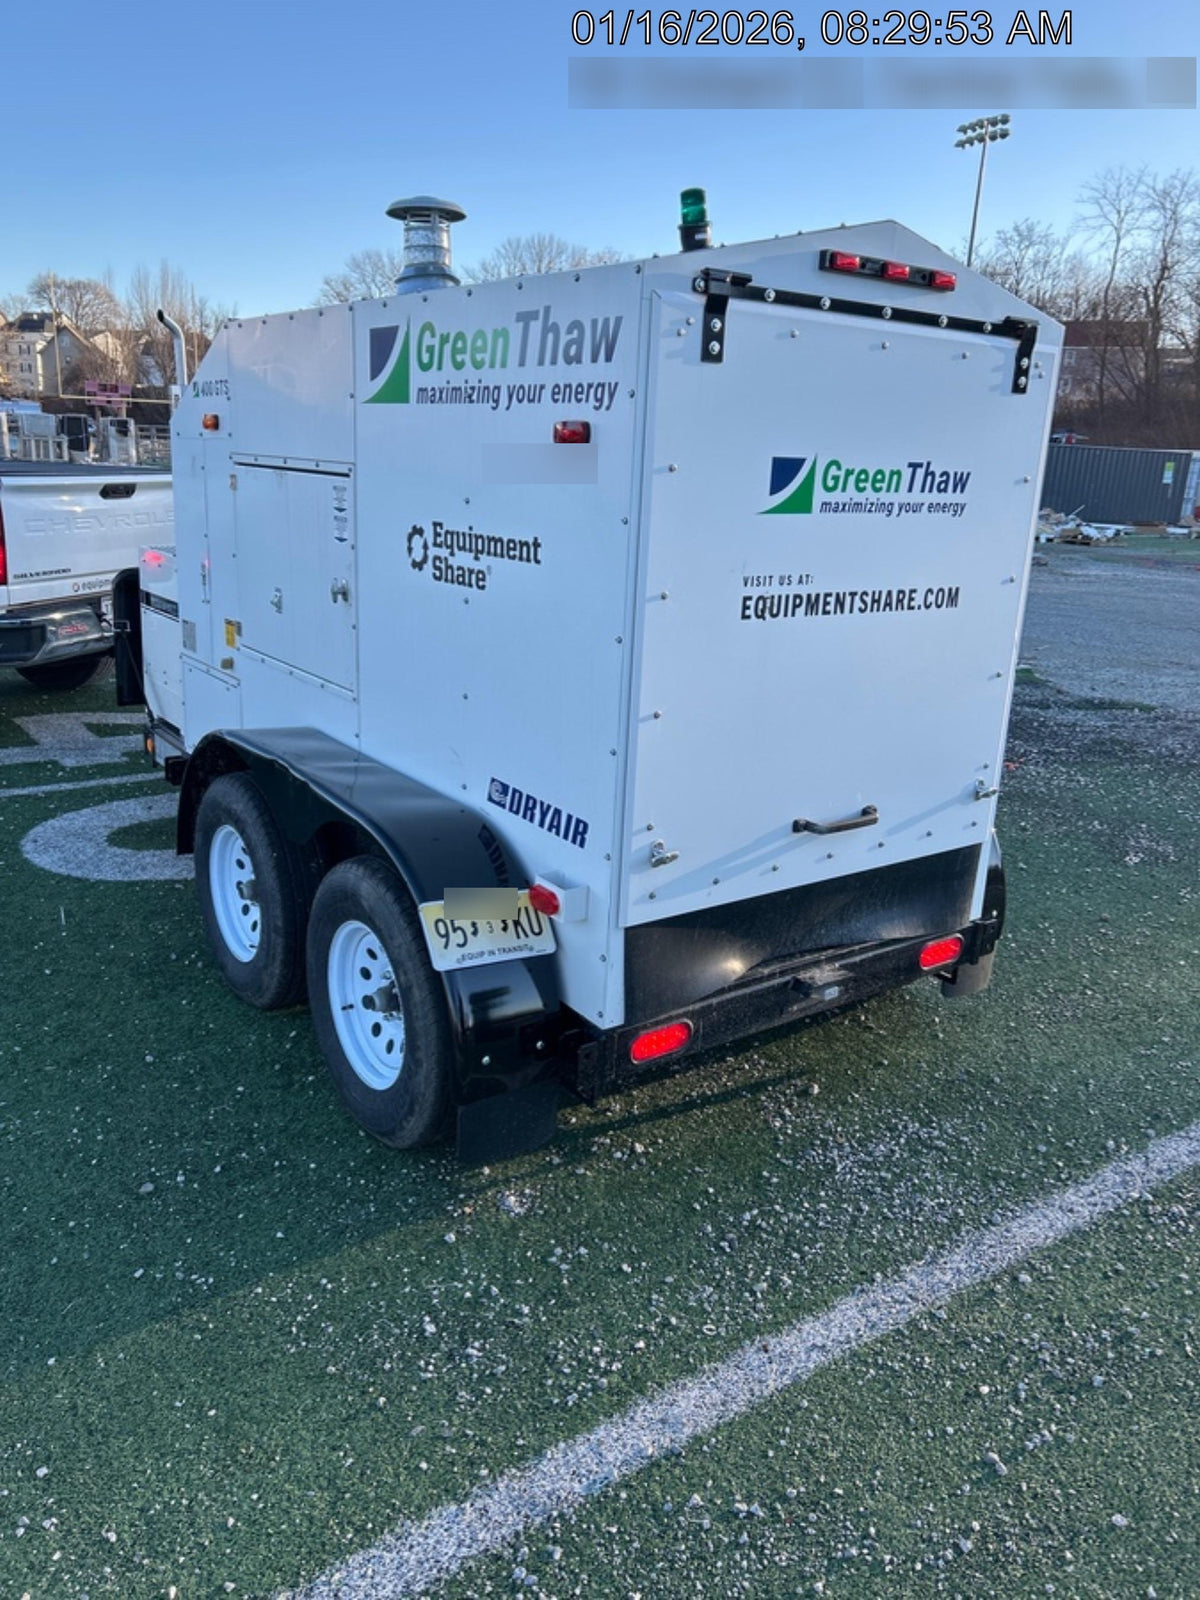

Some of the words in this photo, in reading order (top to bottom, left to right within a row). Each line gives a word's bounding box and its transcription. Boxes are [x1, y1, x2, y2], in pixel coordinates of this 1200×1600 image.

[416, 380, 501, 411] maximizing
[506, 383, 545, 411] your
[551, 381, 619, 411] energy
[819, 498, 894, 517] maximizing
[896, 502, 925, 517] your
[927, 502, 967, 517] energy
[432, 521, 541, 565] Equipment
[743, 575, 774, 587] VISIT
[778, 575, 792, 586] US
[797, 574, 814, 586] AT:
[740, 586, 960, 620] EQUIPMENTSHARE.COM
[508, 787, 589, 849] DRYAIR
